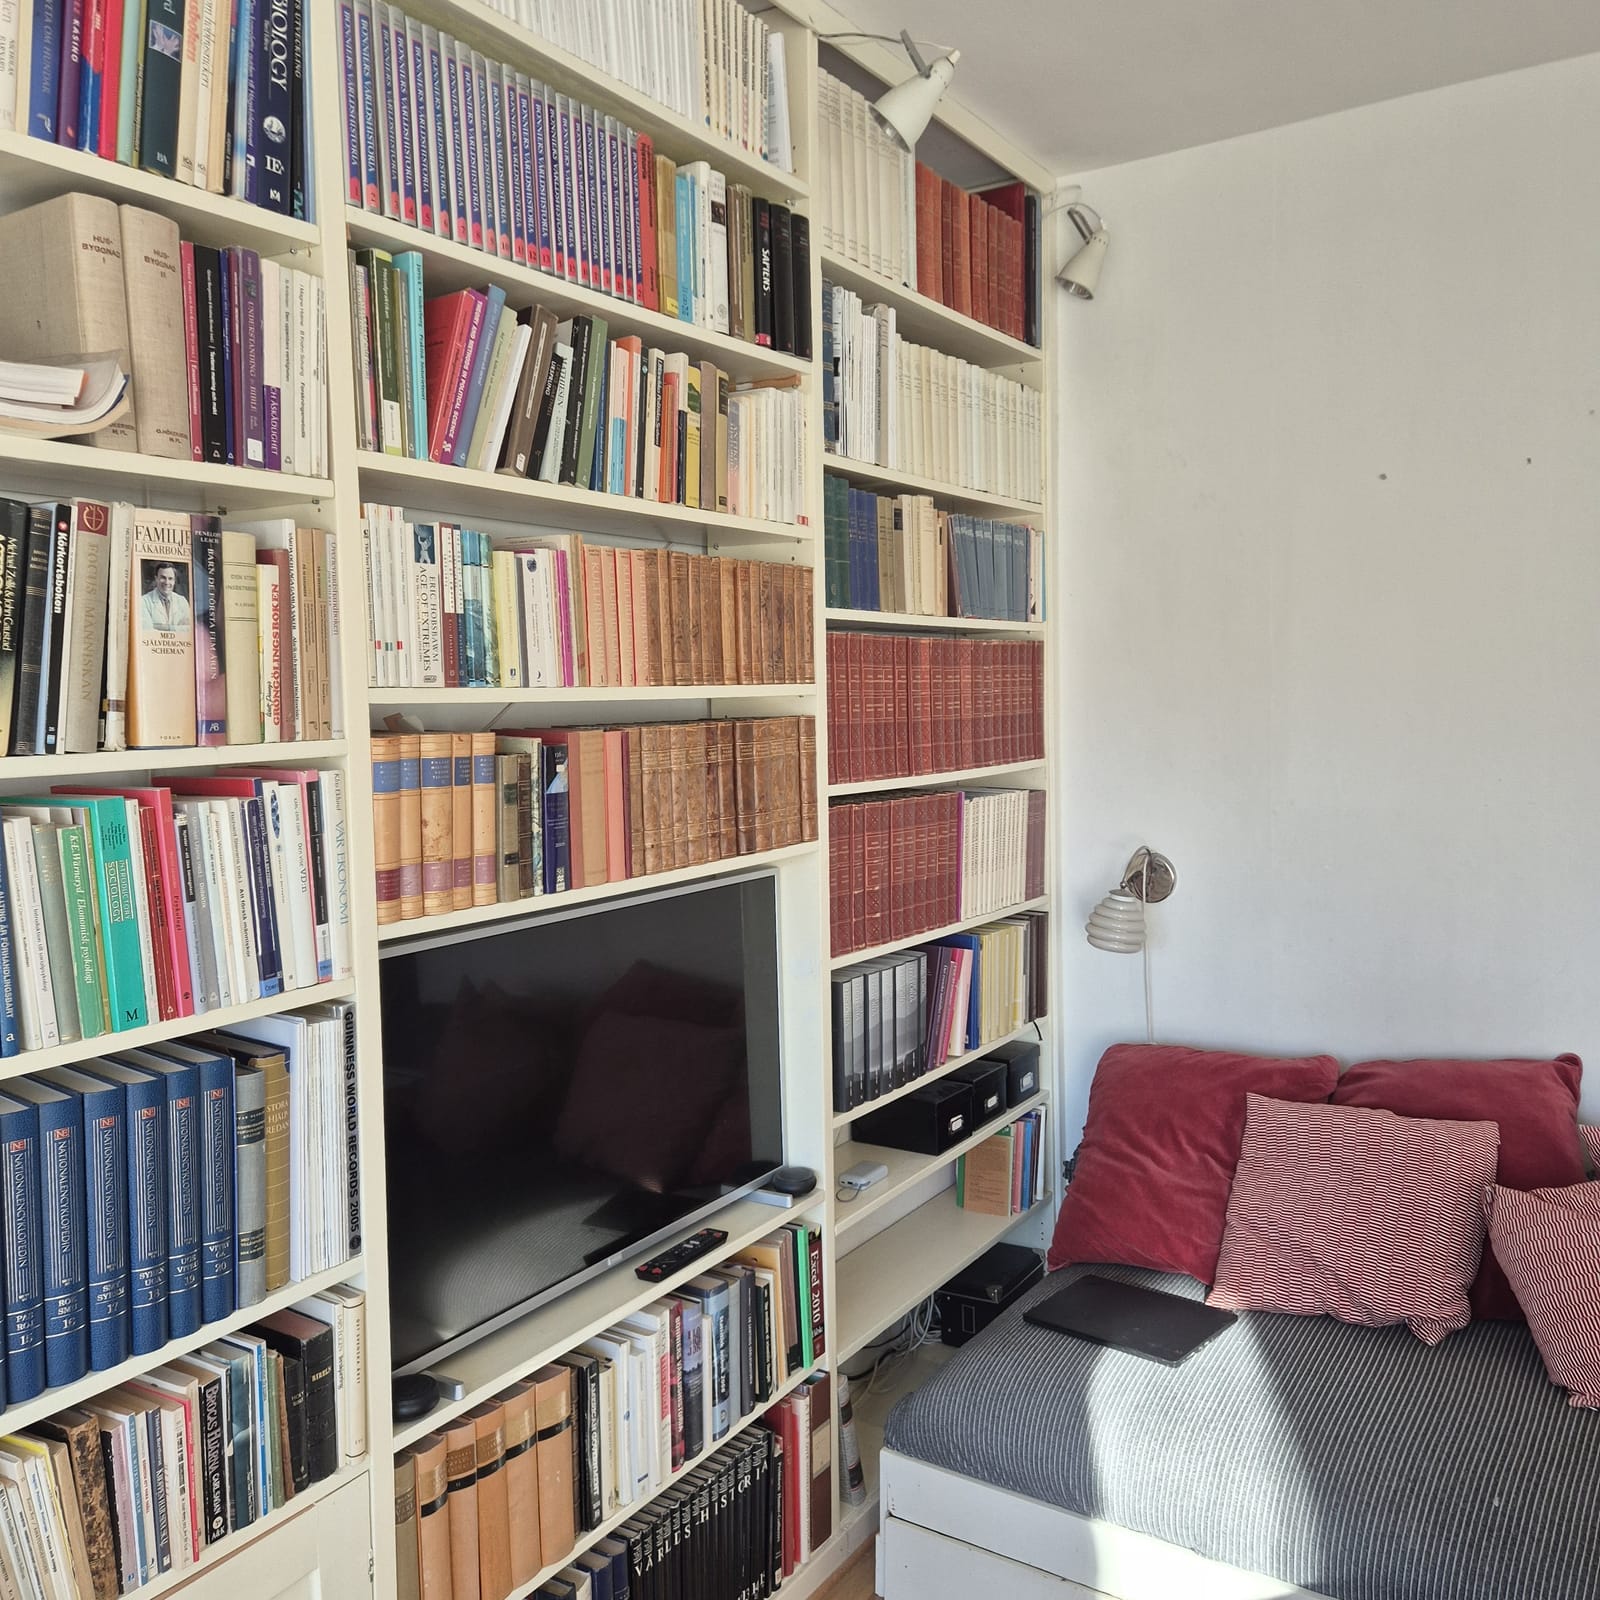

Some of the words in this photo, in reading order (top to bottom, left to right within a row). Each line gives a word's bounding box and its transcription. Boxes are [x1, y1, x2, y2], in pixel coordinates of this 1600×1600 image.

[71, 19, 80, 63] KASINO
[343, 11, 353, 70] BONNIERS
[361, 19, 370, 77] BONNIERS
[397, 36, 406, 93] BONNIERS
[414, 46, 423, 101] BONNIERS
[432, 55, 441, 111] BONNIERS
[448, 63, 459, 118] BONNIERS
[464, 71, 474, 124] BONNIERS
[347, 73, 359, 165] VÄRLDSHISTORIA
[364, 80, 375, 172] VÄRLDSHISTORIA
[492, 87, 502, 139] BONNIERS
[509, 91, 517, 142] BONNIERS
[520, 98, 530, 149] BONNIERS
[535, 103, 545, 154] BONNIERS
[550, 109, 558, 160] BONNIERS
[401, 97, 412, 186] VÄRLDSHISTORIA
[417, 105, 429, 193] VÄRLDSHISTORIA
[435, 113, 447, 200] VÄRLDSHISTORIA
[452, 120, 465, 207] VÄRLDSHISTORIA
[467, 127, 480, 212] VÄRLDSHISTORIA
[496, 142, 508, 224] VÄRLDSHISTORIA
[512, 145, 523, 228] VÄRLDSHISTORIA
[523, 152, 535, 233] VÄRLDSHISTORIA
[538, 156, 548, 237] VÄRLDSHISTORIA
[552, 164, 564, 246] VÄRLDSHISTORIA
[762, 248, 770, 291] SAPIENS
[247, 301, 257, 377] UNDERSTANDING
[469, 326, 478, 340] AND
[473, 300, 483, 325] THEORY
[463, 340, 474, 370] METHODS
[545, 361, 556, 395] URSPRUNG
[454, 379, 467, 409] POLITICAL
[270, 400, 280, 456] ÅSKÅDLIGHET
[449, 410, 460, 439] SCIENCE
[135, 525, 191, 546] FAMILJE
[207, 548, 215, 573] BARN
[53, 532, 68, 614] Körkortsboken
[86, 542, 100, 595] FOCUS
[420, 566, 428, 589] AGE
[429, 576, 437, 600] ERIC
[421, 593, 429, 608] OF
[81, 606, 97, 701] MÄNNISKAN
[142, 640, 192, 648] SJÄLVDIAGNOS
[271, 583, 280, 726] GRÖNGÖLINGSBOKEN
[422, 611, 431, 671] EXTREMES
[430, 603, 439, 662] HOBSBAWM
[335, 819, 347, 848] VÅR
[107, 861, 120, 922] SOCIOLOGY
[119, 860, 131, 920] INTRODUCTORY
[336, 852, 349, 926] EKONOMI
[76, 899, 90, 945] Ekonomisk
[0, 937, 14, 1018] FÖRHANDLINGSBART
[79, 947, 94, 984] psykologi
[344, 1012, 356, 1080] GUINNESS
[346, 1082, 357, 1131] WORLD
[145, 1120, 156, 1226] NATIONALENCYKLOPEDIN
[180, 1110, 191, 1214] NATIONALENCYKLOPEDIN
[214, 1100, 223, 1202] NATIONALENCYKLOPEDIN
[348, 1135, 359, 1198] RECORDS
[13, 1153, 28, 1268] NATIONALENCYKLOPEDIN
[58, 1141, 71, 1253] NATIONALENCYKLOPEDIN
[103, 1129, 114, 1239] NATIONALENCYKLOPEDIN
[350, 1201, 360, 1233] 2005
[810, 1249, 821, 1286] Excel
[811, 1292, 822, 1323] 2010
[205, 1384, 221, 1432] BROCAS
[590, 1382, 600, 1431] AMERICAN
[676, 1360, 684, 1433] VÄRLDSHISTORIA
[207, 1432, 222, 1474] HJÄRNA
[590, 1432, 600, 1497] GOVERNMENT
